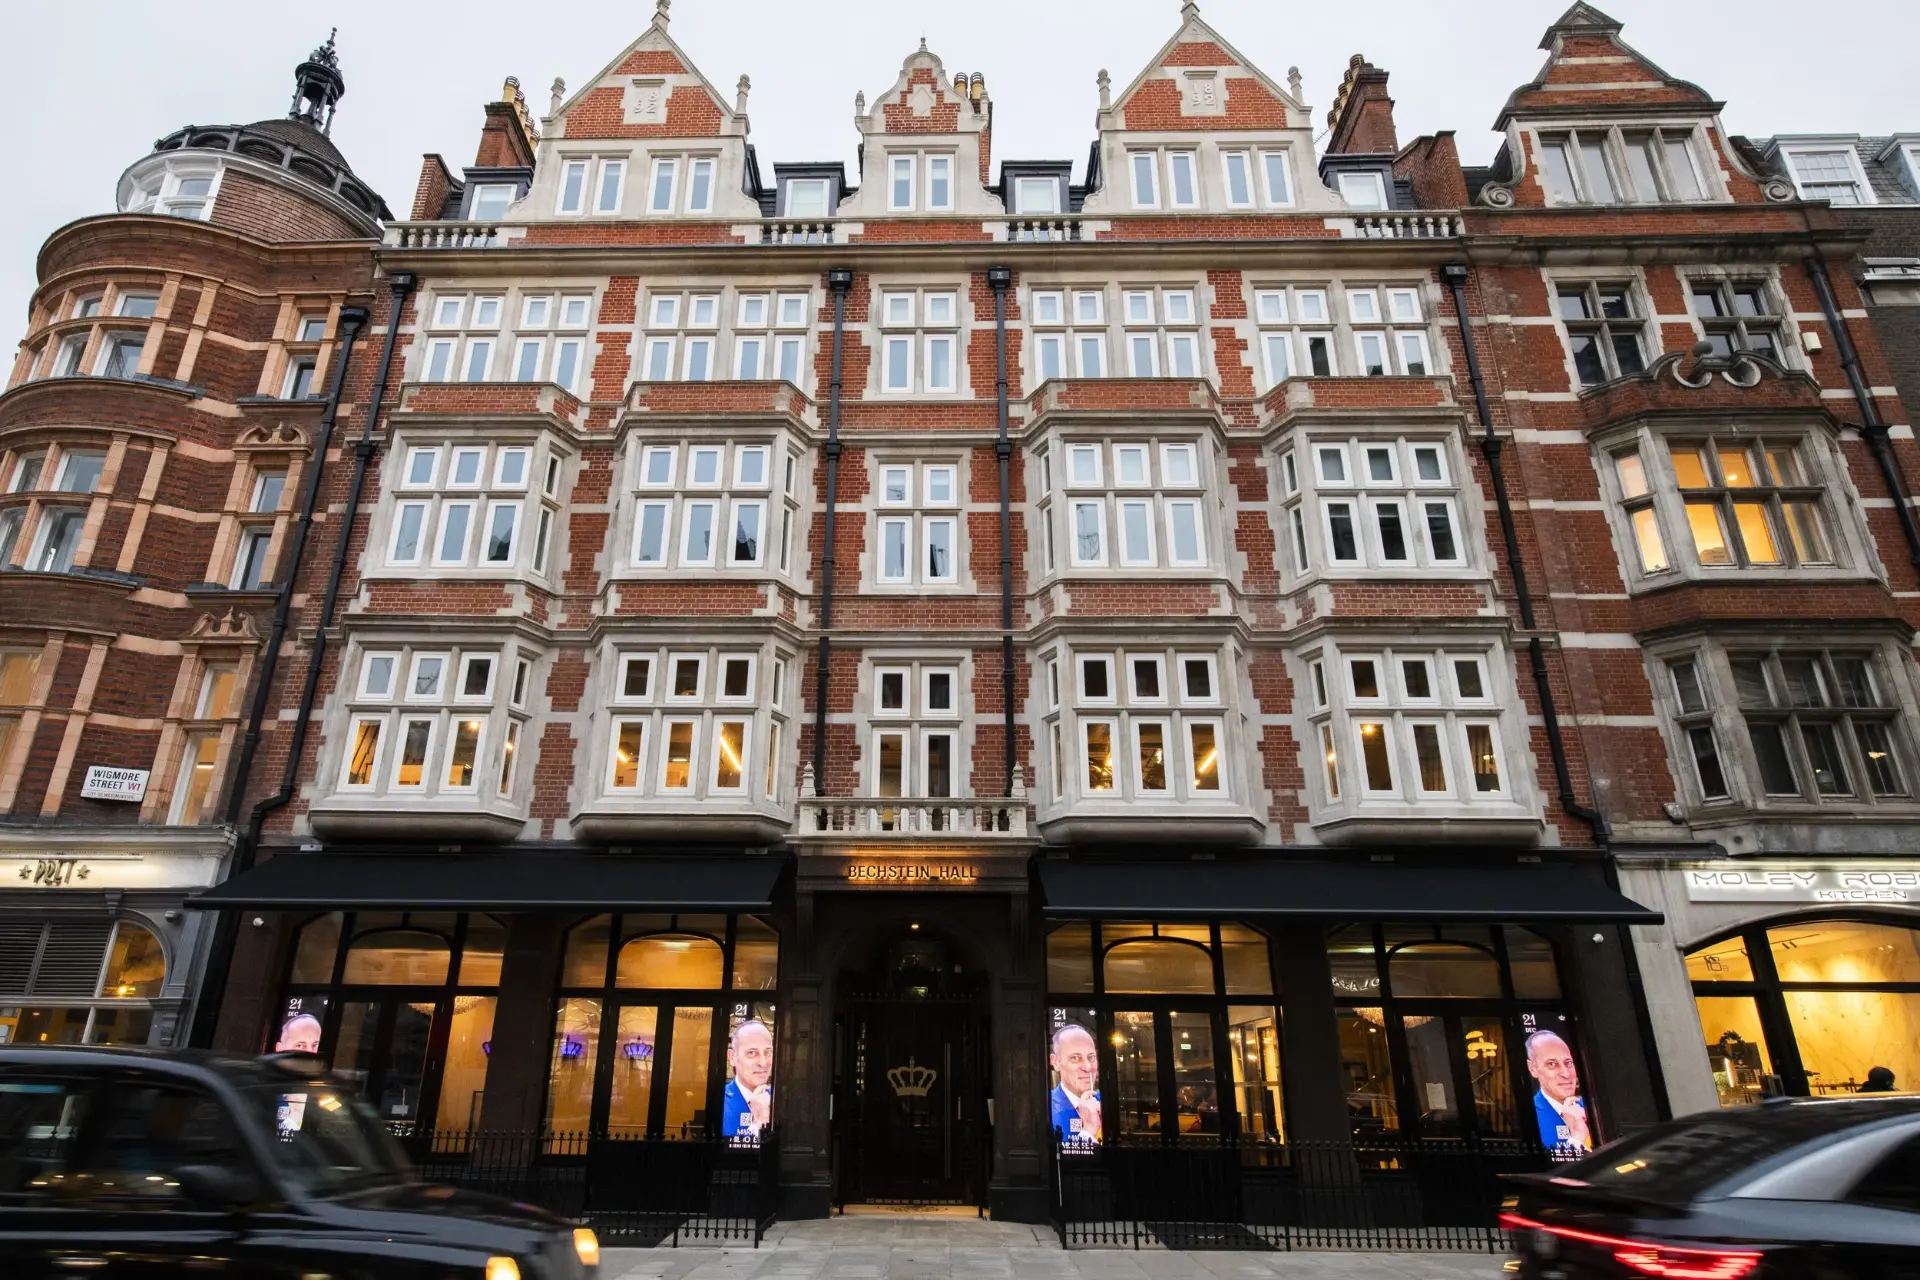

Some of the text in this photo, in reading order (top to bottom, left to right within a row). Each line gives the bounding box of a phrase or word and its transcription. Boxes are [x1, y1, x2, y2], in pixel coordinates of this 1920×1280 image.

[94, 769, 140, 782] WIGMORE
[90, 779, 141, 791] STREET W1
[848, 865, 977, 879] BECHSTEIN HALL
[1693, 872, 1920, 886] MOLEY ROB
[1819, 890, 1908, 899] KITCHEN
[289, 998, 303, 1010] 21
[735, 1004, 748, 1016] 21
[1053, 1008, 1066, 1020] 21
[1522, 1013, 1536, 1026] 21
